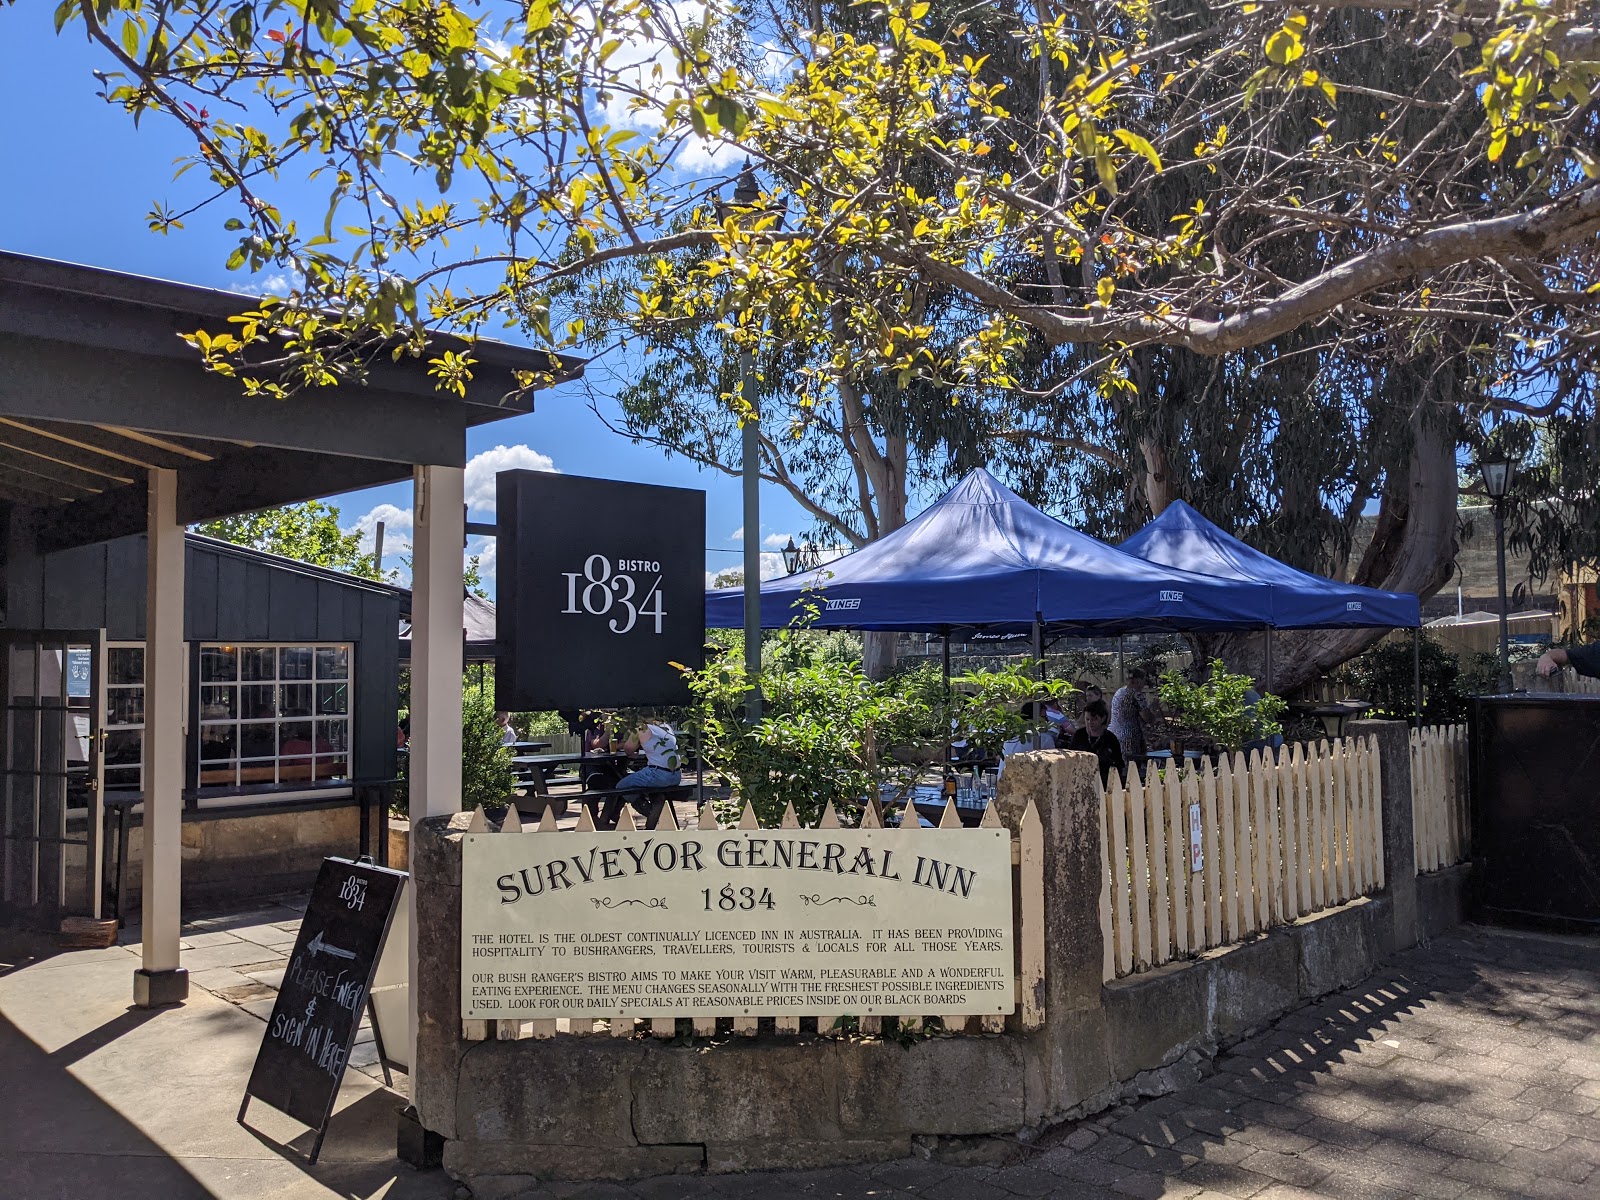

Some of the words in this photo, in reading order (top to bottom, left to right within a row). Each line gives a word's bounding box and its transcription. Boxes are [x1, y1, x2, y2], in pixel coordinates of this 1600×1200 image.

[618, 559, 660, 573] BISTRO
[561, 554, 667, 634] 1834
[1160, 590, 1184, 602] KINGS
[826, 599, 861, 610] KINGS
[496, 837, 706, 905] SURVEYOR
[717, 839, 902, 882] GENERAL
[911, 855, 978, 900] INN
[338, 875, 368, 912] 1834
[701, 882, 776, 911] 1834
[471, 934, 493, 944] THE
[499, 934, 533, 944] HOTEL
[539, 933, 549, 943] IS
[553, 933, 575, 943] THE
[580, 932, 622, 943] OLDEST
[627, 931, 700, 942] CONTINUALLY
[705, 931, 755, 941] LICENCED
[761, 930, 778, 941] INN
[784, 930, 793, 941] IN
[799, 930, 861, 940] AUSTRALIA.
[872, 929, 882, 940] IT
[888, 929, 909, 939] HAS
[914, 929, 942, 939] BEEN
[947, 928, 1002, 939] PROVIDING
[472, 945, 545, 957] HOSPITALITY
[551, 946, 566, 956] TO
[573, 945, 655, 957] BUSHRANGERS,
[662, 944, 735, 956] TRAVELLERS,
[742, 943, 794, 954] TOURISTS
[801, 943, 810, 954] &
[817, 942, 859, 954] LOCALS
[866, 942, 886, 953] FOR
[893, 942, 914, 953] ALL
[921, 941, 957, 952] THOSE
[964, 941, 1003, 952] YEARS.
[471, 973, 493, 983] OUR
[498, 973, 526, 983] BUSH
[531, 972, 583, 983] RANGER'S
[587, 971, 626, 982] BISTRO
[630, 971, 657, 982] AIMS
[661, 971, 676, 981] TO
[680, 970, 711, 981] MAKE
[715, 970, 744, 981] YOUR
[748, 970, 776, 980] VISIT
[780, 969, 815, 981] WARM,
[820, 968, 896, 979] PLEASURABLE
[901, 968, 923, 979] AND
[927, 968, 935, 978] A
[939, 967, 1003, 978] WONDERFUL
[290, 956, 333, 997] PLEASE
[331, 969, 364, 1019] ENTER
[472, 986, 511, 996] EATING
[514, 986, 582, 996] EXPERIENCE.
[587, 985, 609, 995] THE
[612, 985, 642, 995] MENU
[645, 984, 695, 994] CHANGES
[697, 982, 767, 994] SEASONALLY
[770, 983, 797, 993] WITH
[800, 982, 821, 993] THE
[824, 982, 879, 992] FRESHEST
[881, 981, 932, 992] POSSIBLE
[935, 980, 1004, 991] INGREDIENTS
[472, 999, 502, 1009] USED.
[508, 999, 536, 1009] LOOK
[539, 999, 559, 1008] FOR
[562, 998, 583, 1008] OUR
[586, 997, 618, 1008] DAILY
[620, 997, 672, 1008] SPECIALS
[675, 997, 689, 1007] AT
[692, 996, 763, 1007] REASONABLE
[766, 995, 803, 1006] PRICES
[806, 995, 840, 1006] INSIDE
[843, 995, 857, 1005] ON
[860, 994, 881, 1005] OUR
[884, 994, 920, 1005] BLACK
[923, 993, 966, 1004] BOARDS
[305, 996, 318, 1027] &
[272, 1013, 306, 1047] SIGN
[304, 1025, 324, 1060] IN
